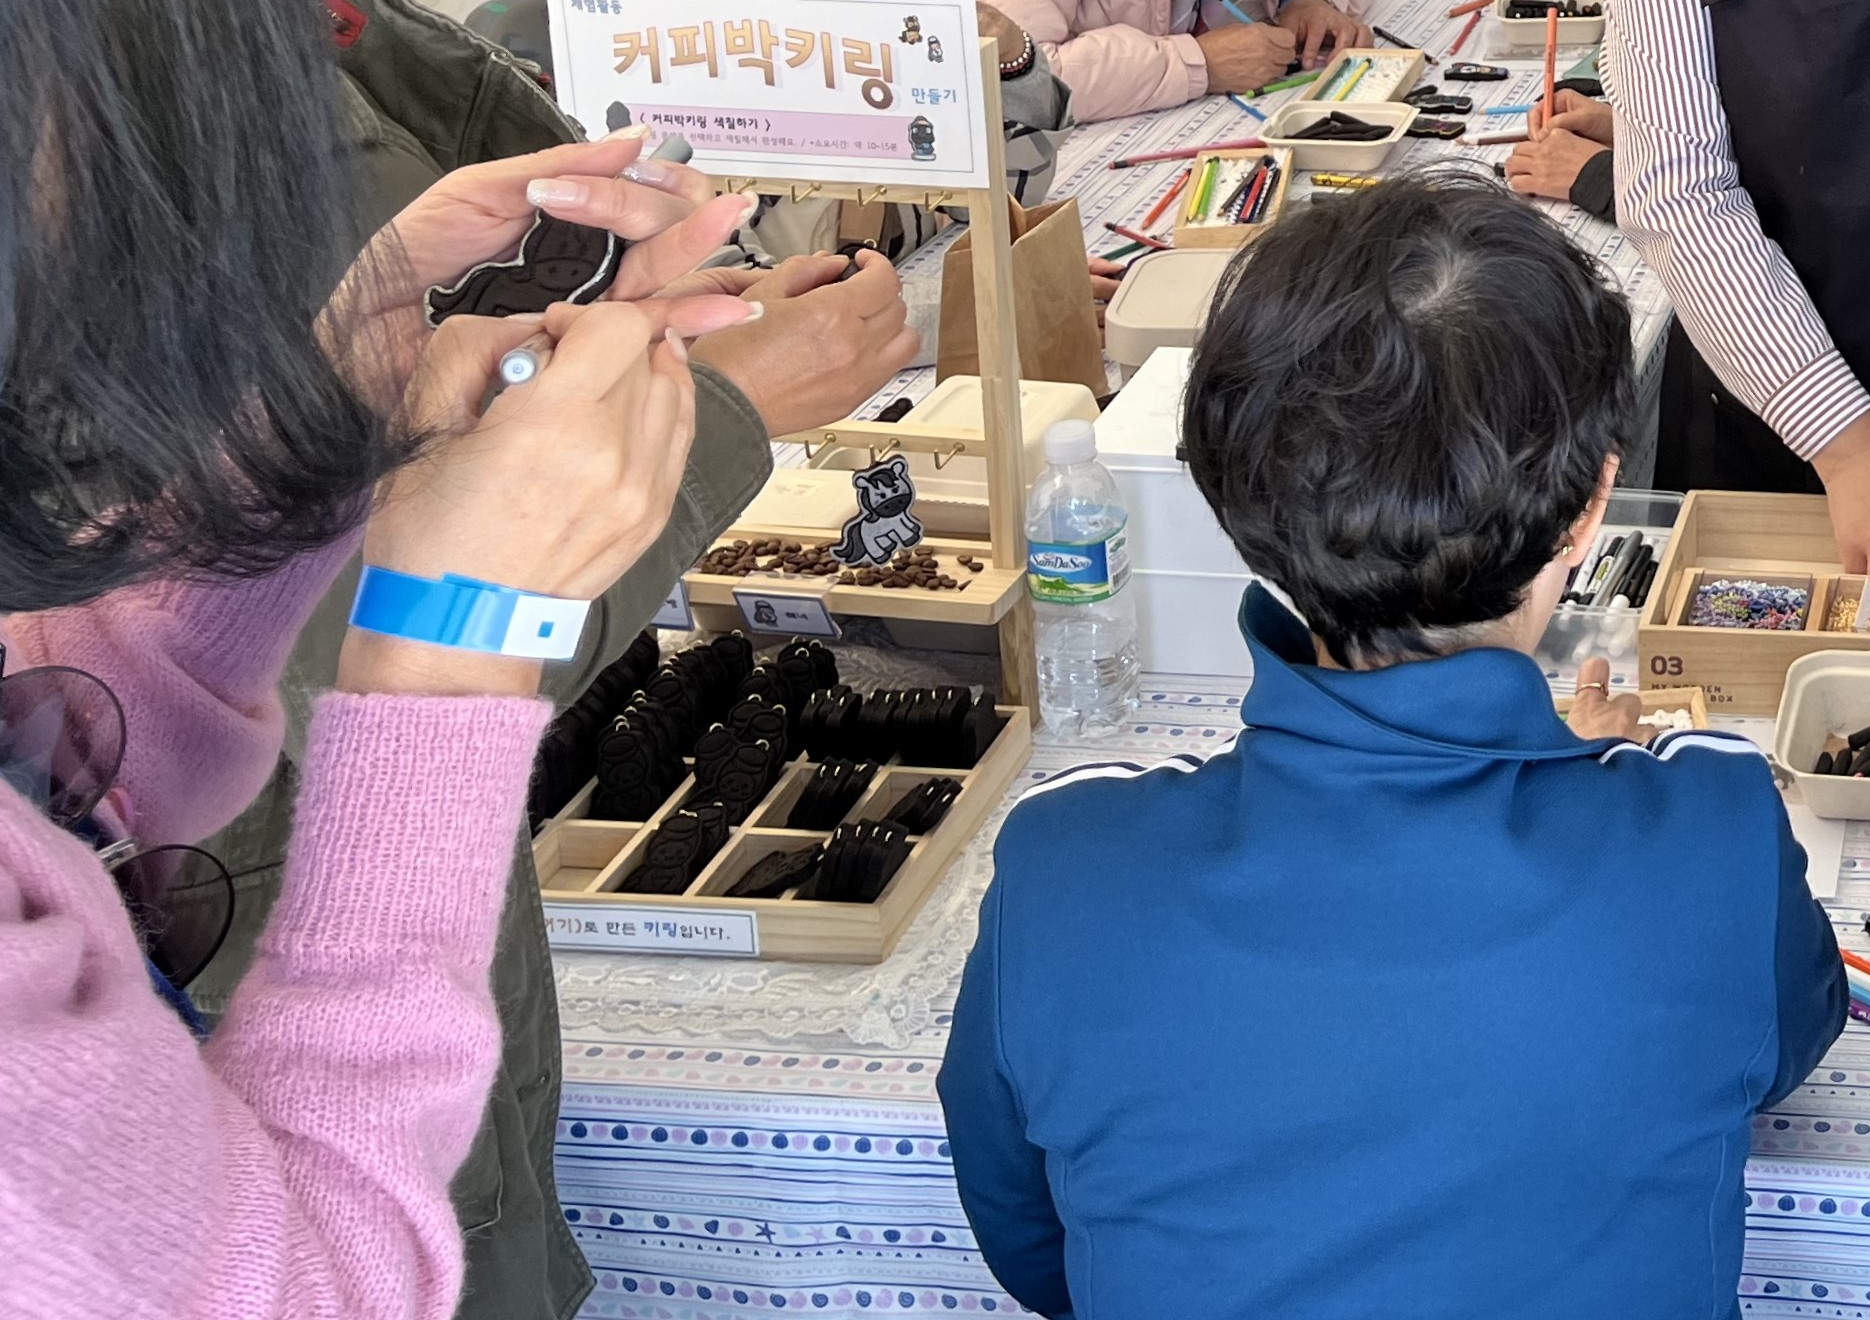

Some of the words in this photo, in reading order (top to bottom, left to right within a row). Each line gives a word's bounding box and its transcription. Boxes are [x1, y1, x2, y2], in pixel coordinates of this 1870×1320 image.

[613, 18, 894, 110] 커피박키링
[911, 87, 957, 105] 만들기
[652, 114, 706, 128] 커피박키링
[714, 116, 758, 130] 색칠하기
[1651, 655, 1683, 676] 03
[606, 921, 636, 936] 만든
[643, 921, 731, 941] 키링입니다.
